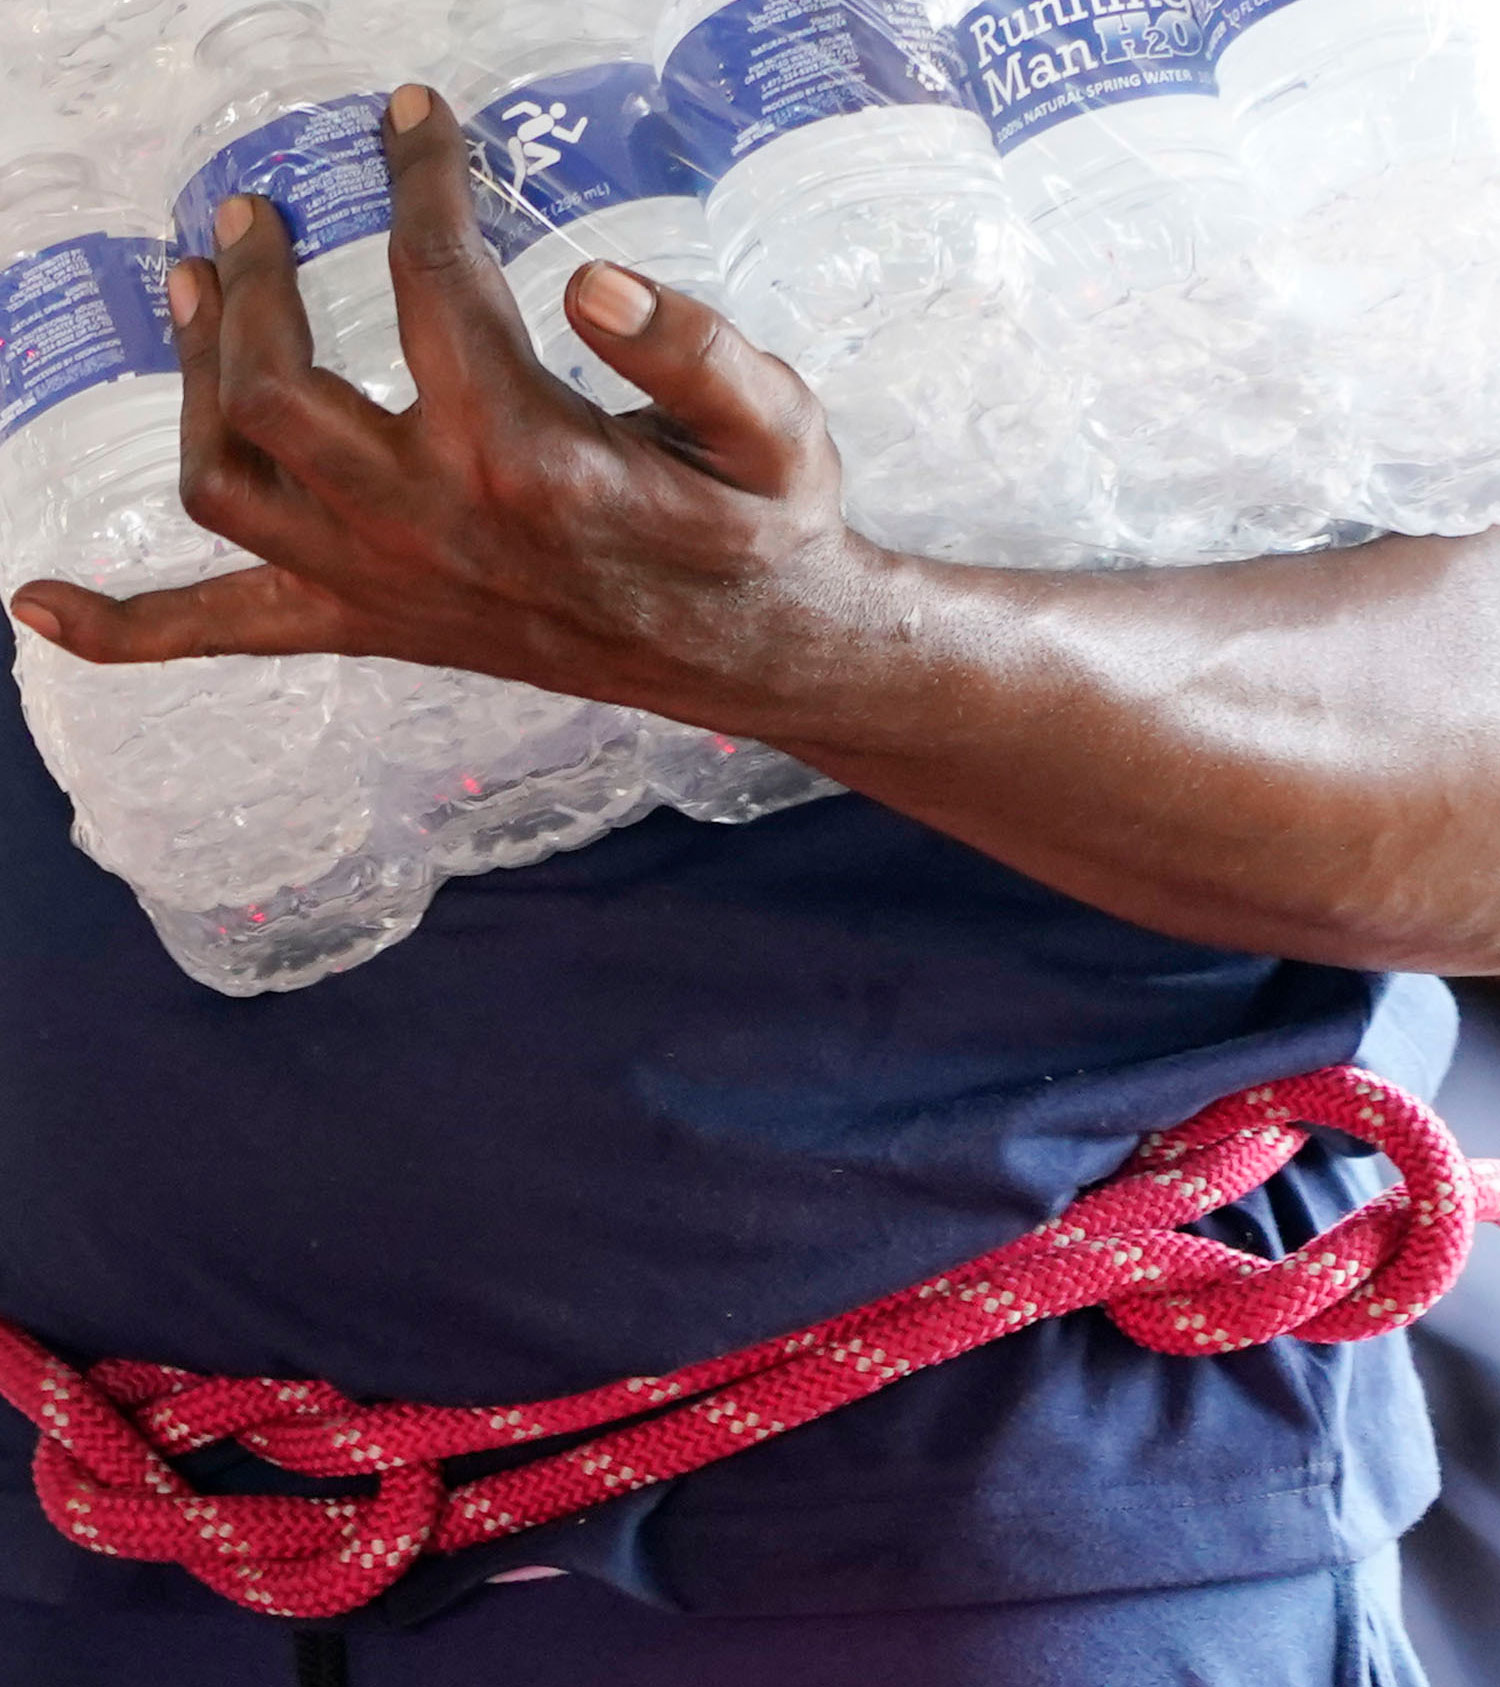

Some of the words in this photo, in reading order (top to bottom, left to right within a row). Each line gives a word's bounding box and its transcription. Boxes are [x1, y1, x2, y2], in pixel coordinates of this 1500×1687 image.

[981, 38, 1098, 117] Man
[1023, 88, 1085, 124] NATURAL
[1085, 72, 1141, 100] SPRING
[1143, 68, 1193, 84] WATER
